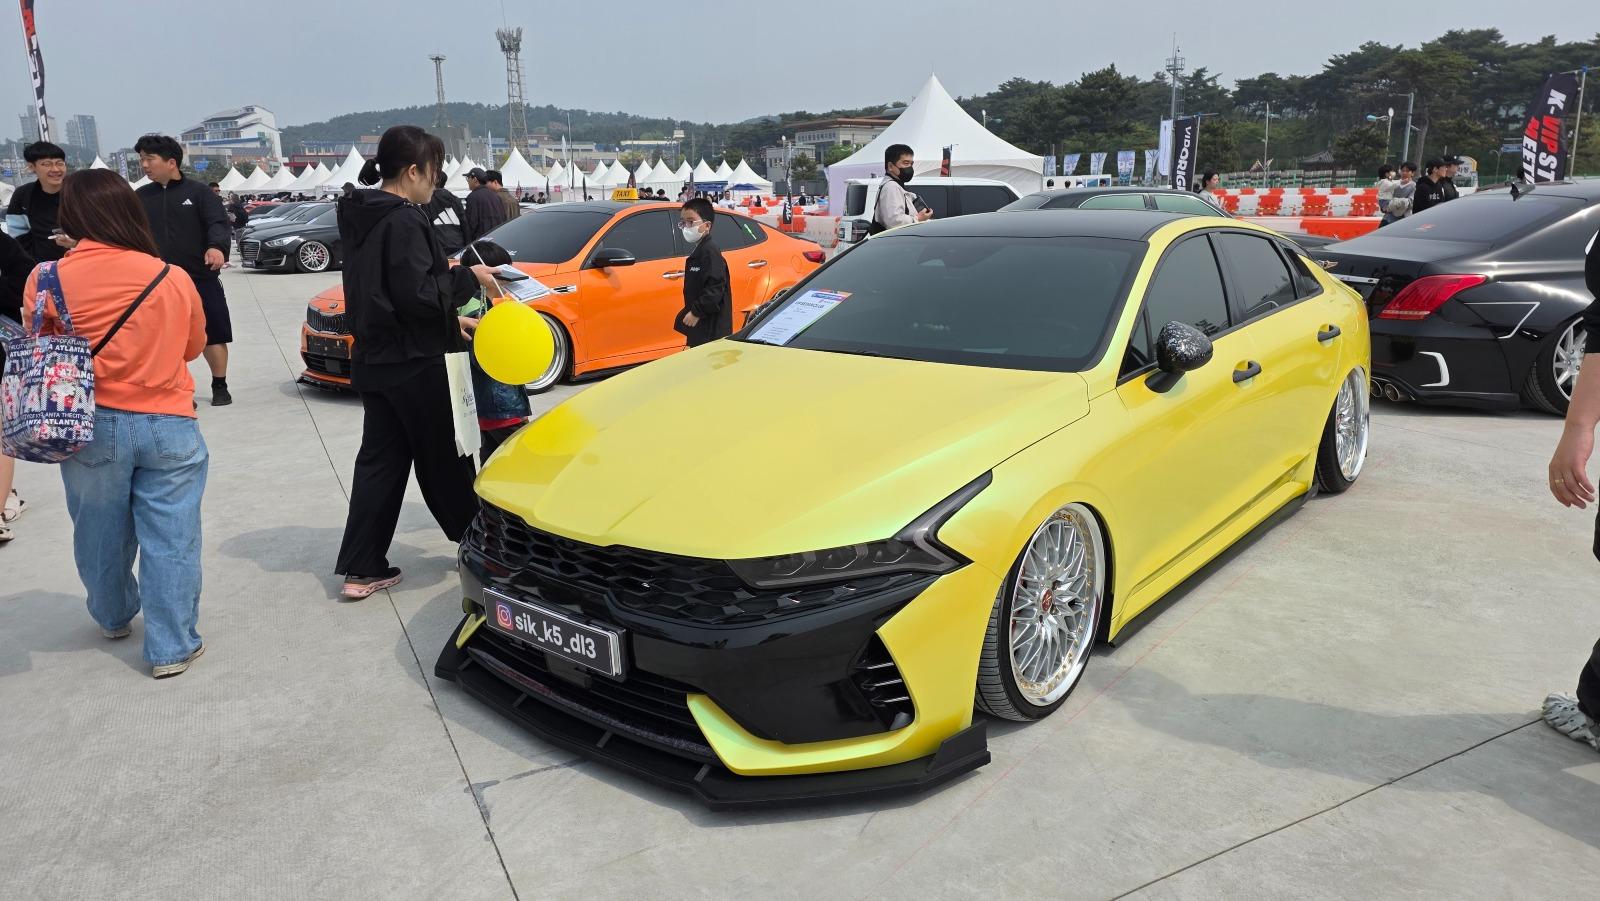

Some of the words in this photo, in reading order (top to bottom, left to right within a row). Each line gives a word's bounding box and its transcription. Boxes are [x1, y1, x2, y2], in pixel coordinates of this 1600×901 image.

[1541, 88, 1567, 154] K-VIP
[1537, 151, 1558, 183] ST
[44, 418, 79, 426] ATLANTA
